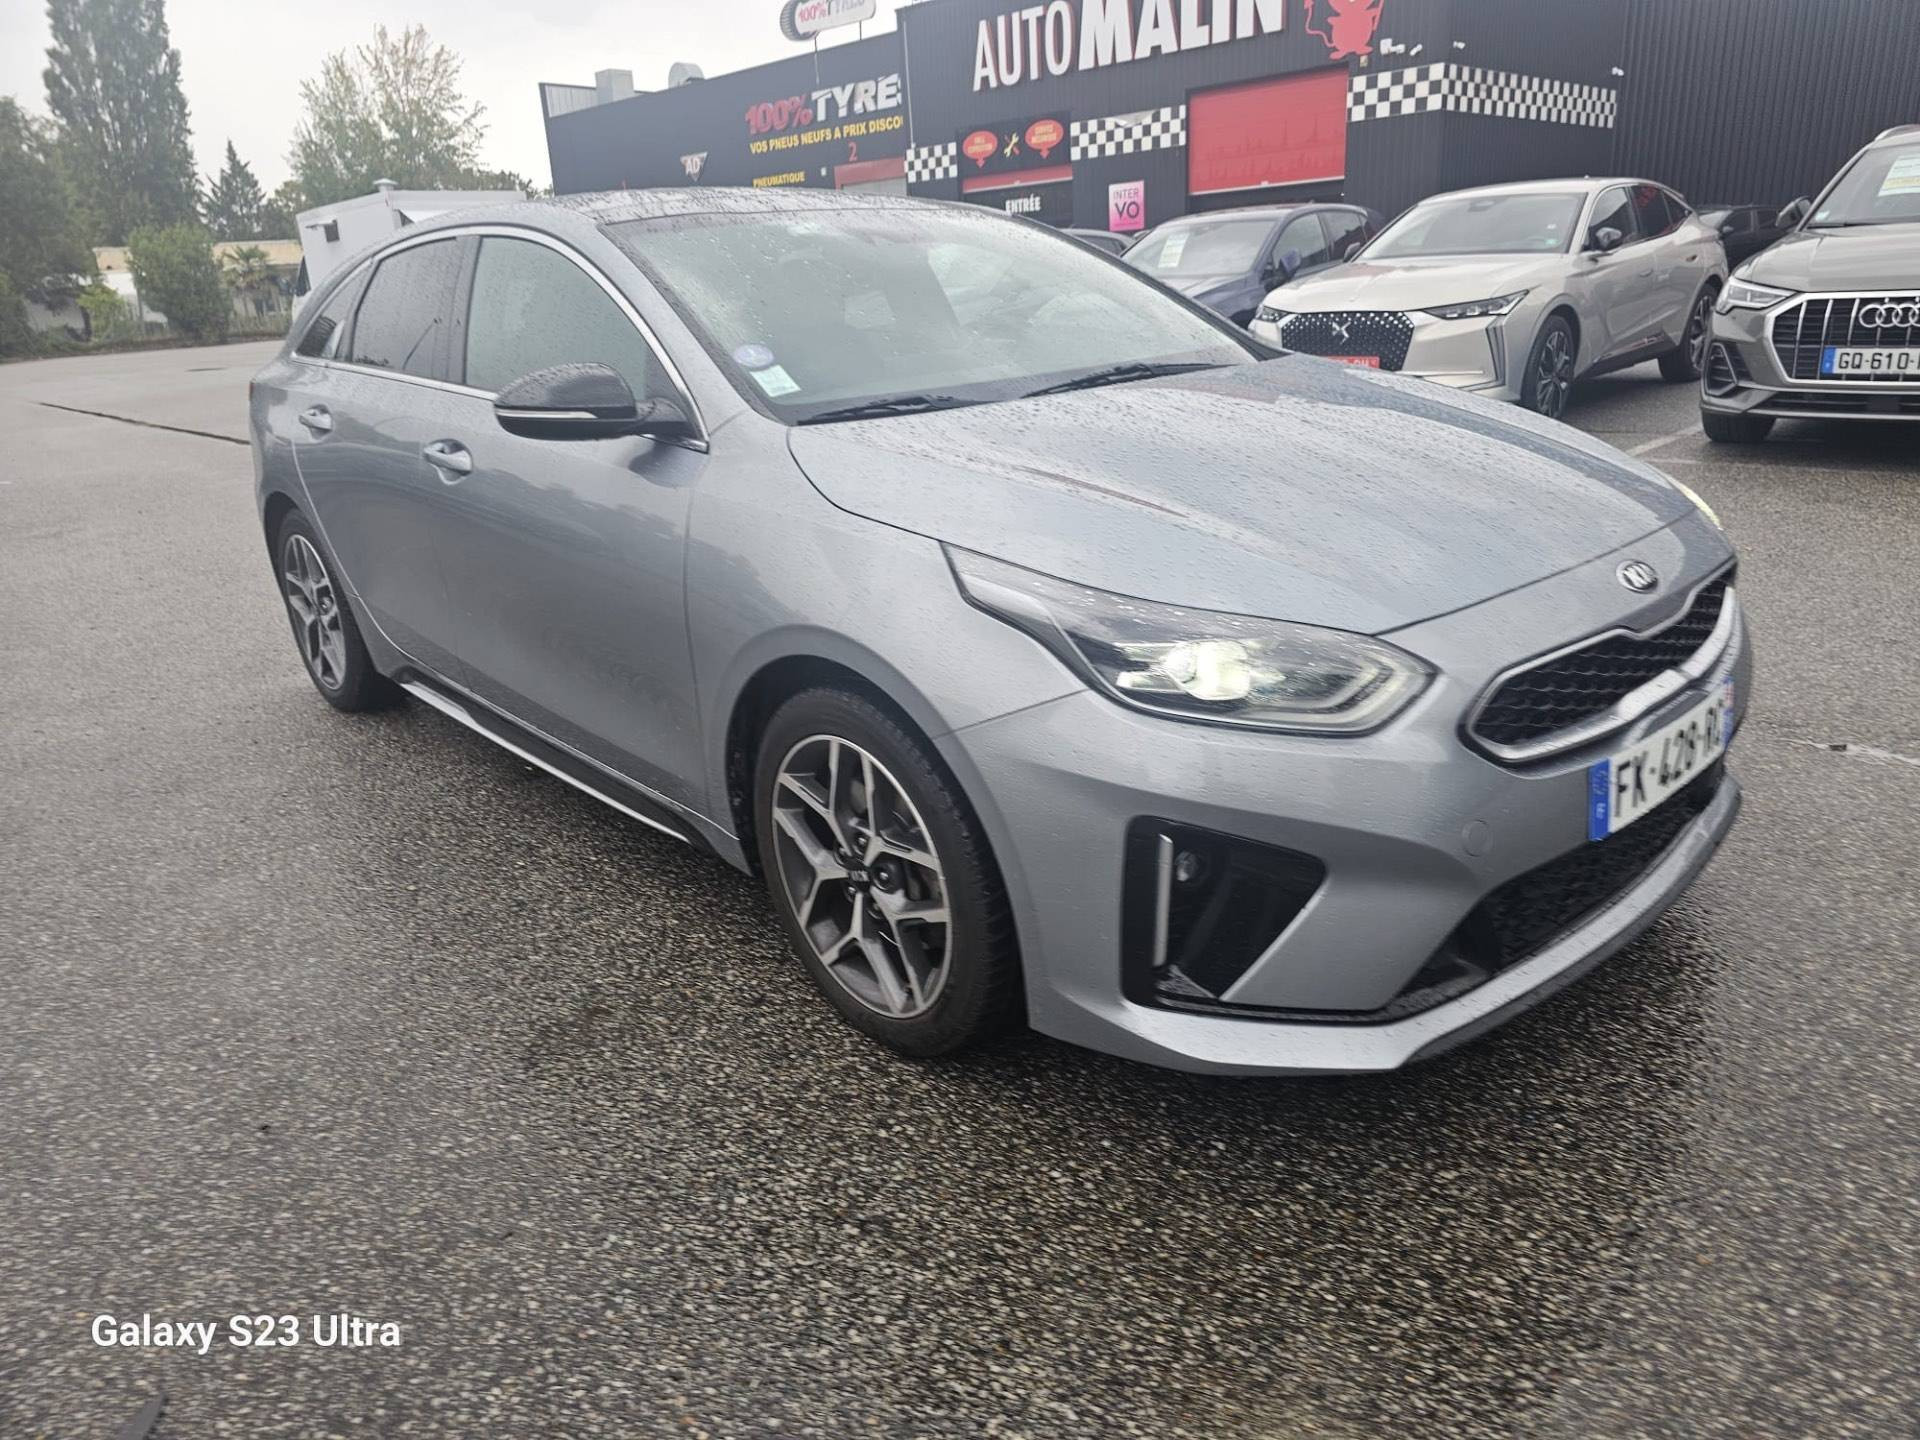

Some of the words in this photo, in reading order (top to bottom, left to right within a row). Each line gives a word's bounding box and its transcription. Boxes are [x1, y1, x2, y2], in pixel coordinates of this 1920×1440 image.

[811, 73, 902, 122] TYRE
[750, 139, 768, 154] VOS
[769, 135, 799, 151] PNEUS
[801, 128, 832, 145] NEUFS
[834, 126, 842, 140] A
[843, 123, 866, 138] PRIX
[869, 115, 903, 133] DISCO
[848, 142, 858, 162] 2
[1114, 201, 1140, 219] VO
[1838, 352, 1920, 371] GQ-610-
